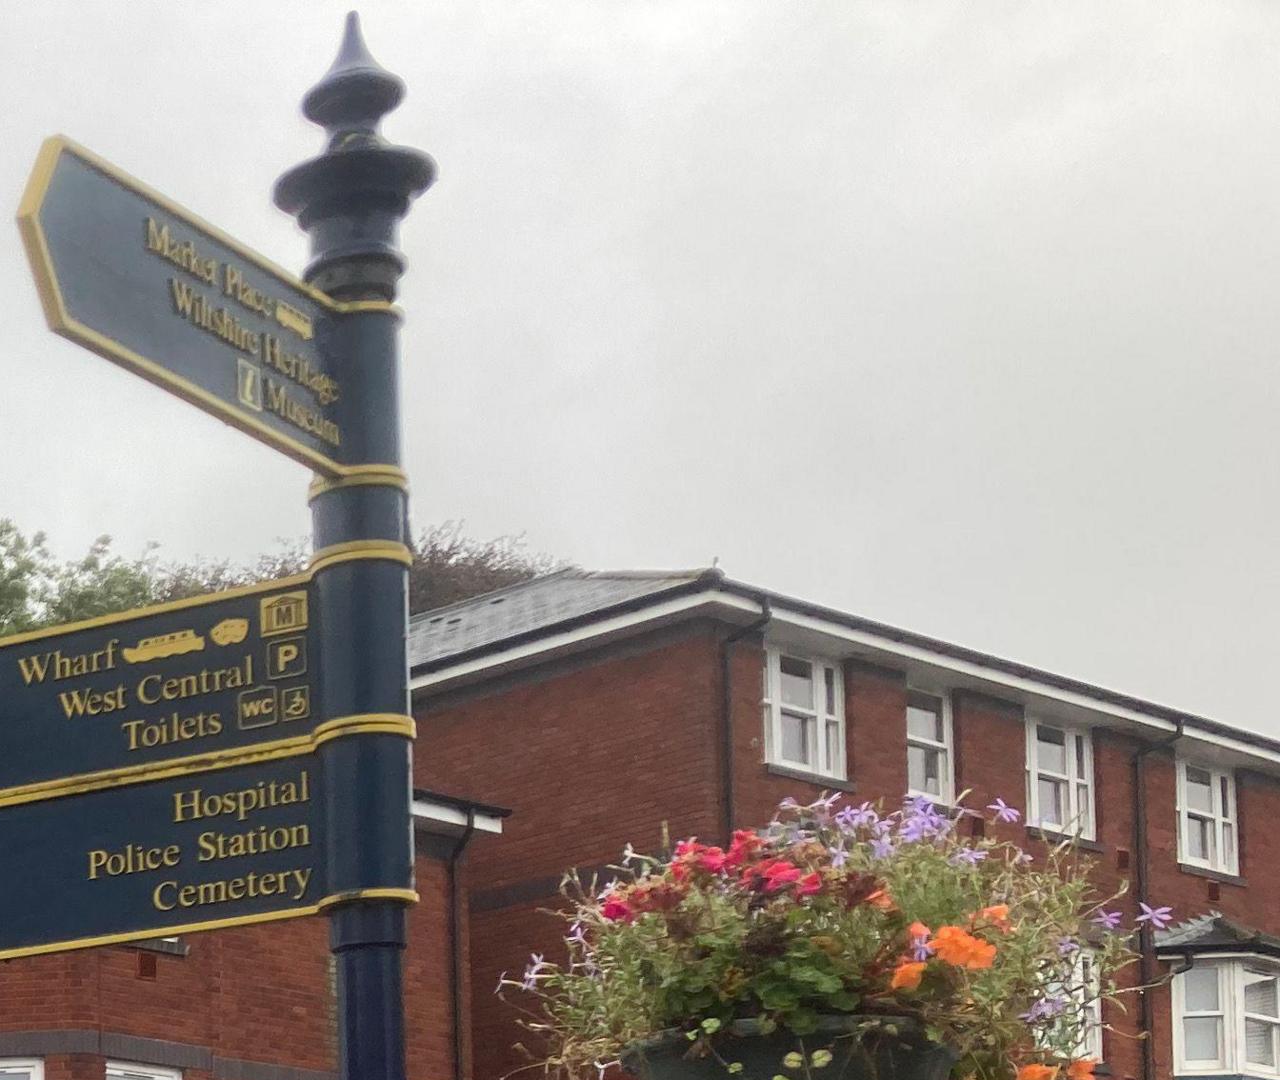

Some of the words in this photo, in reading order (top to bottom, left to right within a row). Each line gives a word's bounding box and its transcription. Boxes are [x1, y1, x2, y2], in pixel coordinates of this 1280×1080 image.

[145, 217, 217, 286] Market
[223, 264, 273, 317] Place
[168, 278, 259, 354] Wiltshire
[260, 333, 340, 405] Heritage
[262, 377, 340, 446] Museum
[18, 639, 120, 685] Wharf
[57, 685, 128, 720] West
[136, 655, 255, 704] Central
[121, 711, 223, 751] Toilets
[242, 697, 275, 718] WC
[172, 771, 311, 822] Hospital
[87, 843, 182, 880] Police
[197, 823, 311, 862] Station
[153, 868, 312, 911] Cemetery
